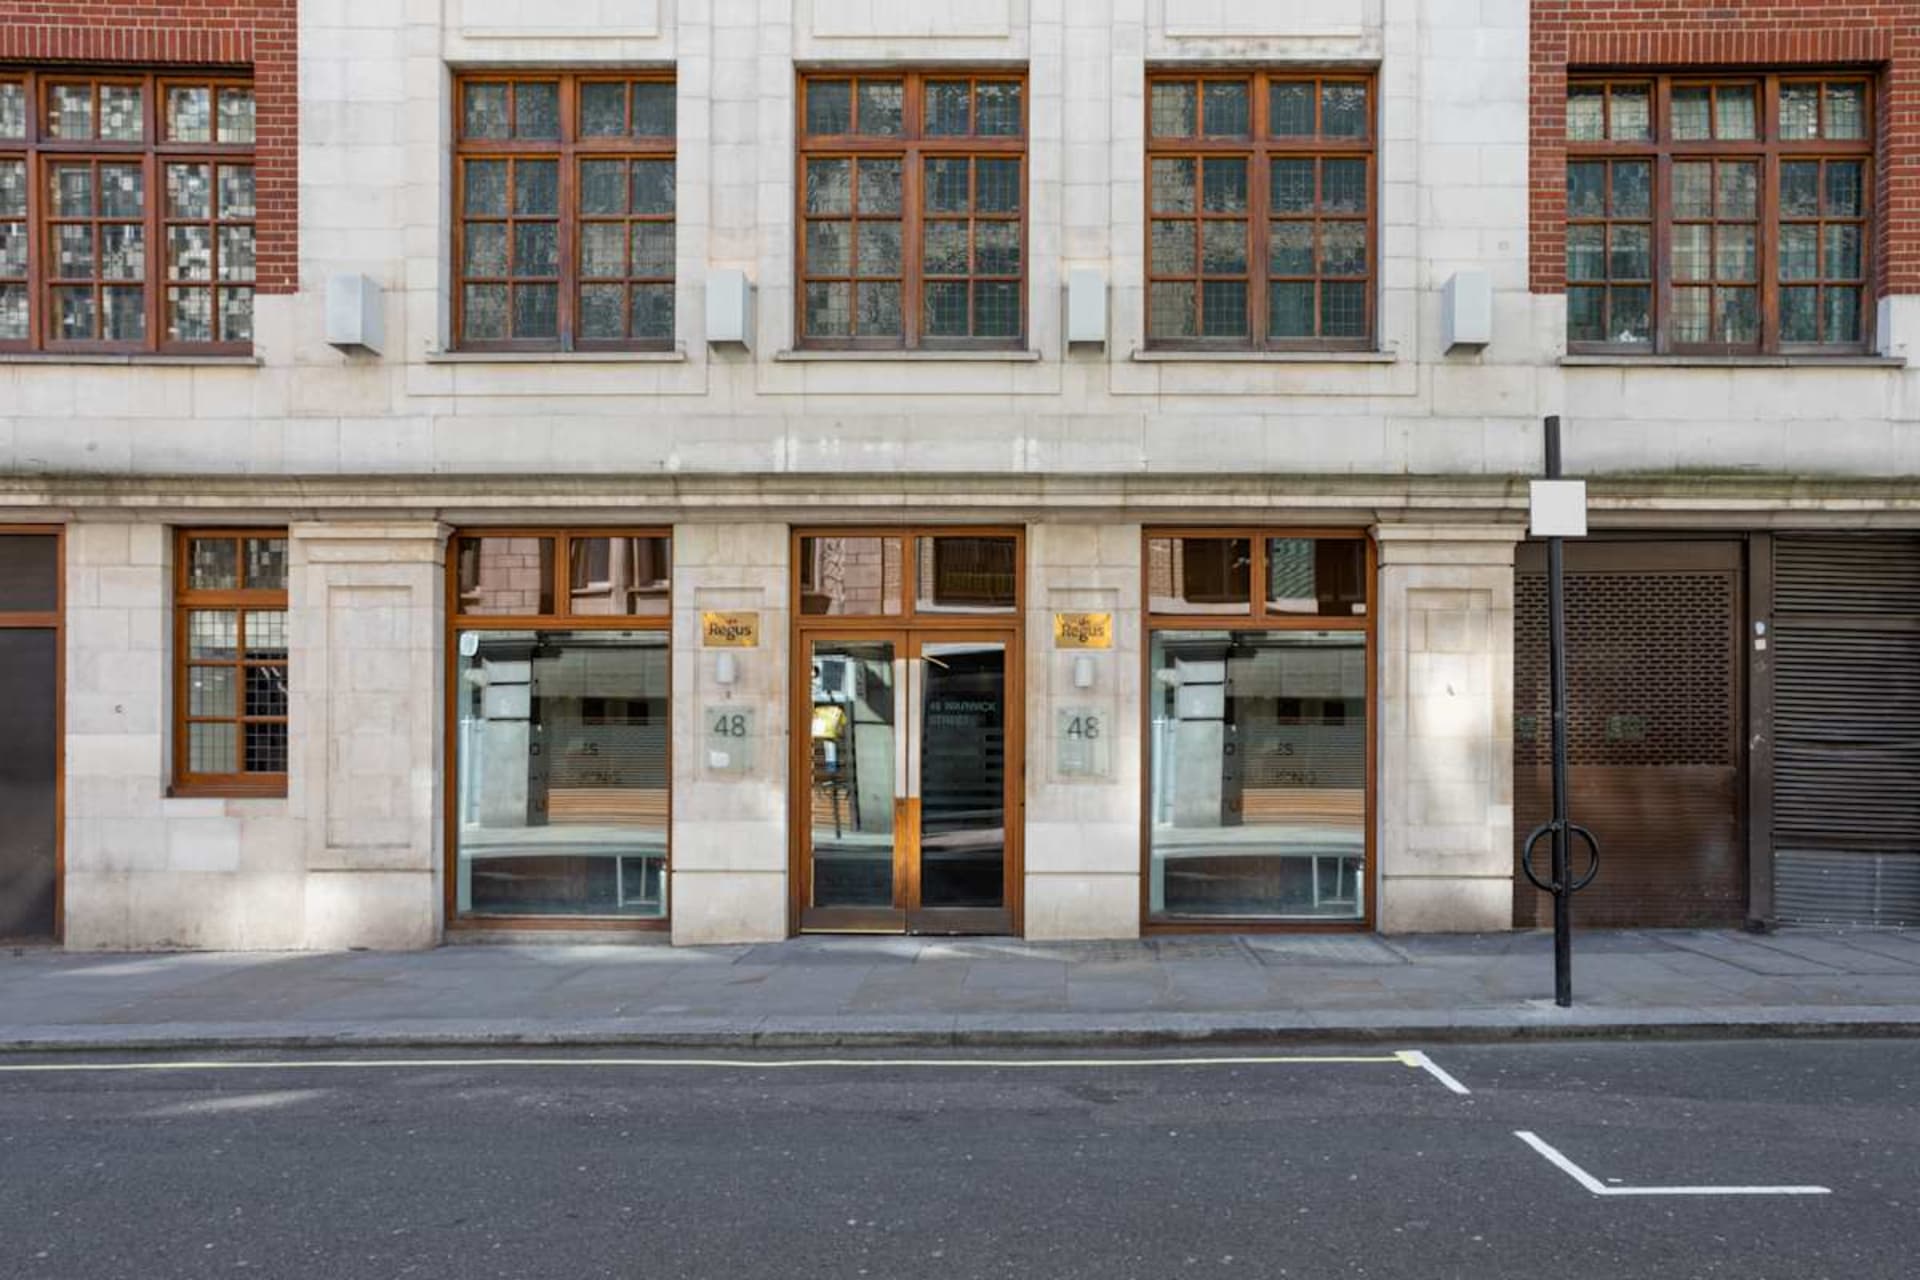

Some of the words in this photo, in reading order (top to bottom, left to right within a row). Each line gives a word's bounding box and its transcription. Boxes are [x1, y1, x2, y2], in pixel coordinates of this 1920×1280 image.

[708, 621, 752, 641] Regus
[1061, 623, 1105, 643] Regus
[713, 714, 746, 738] 48
[1066, 715, 1100, 740] 48
